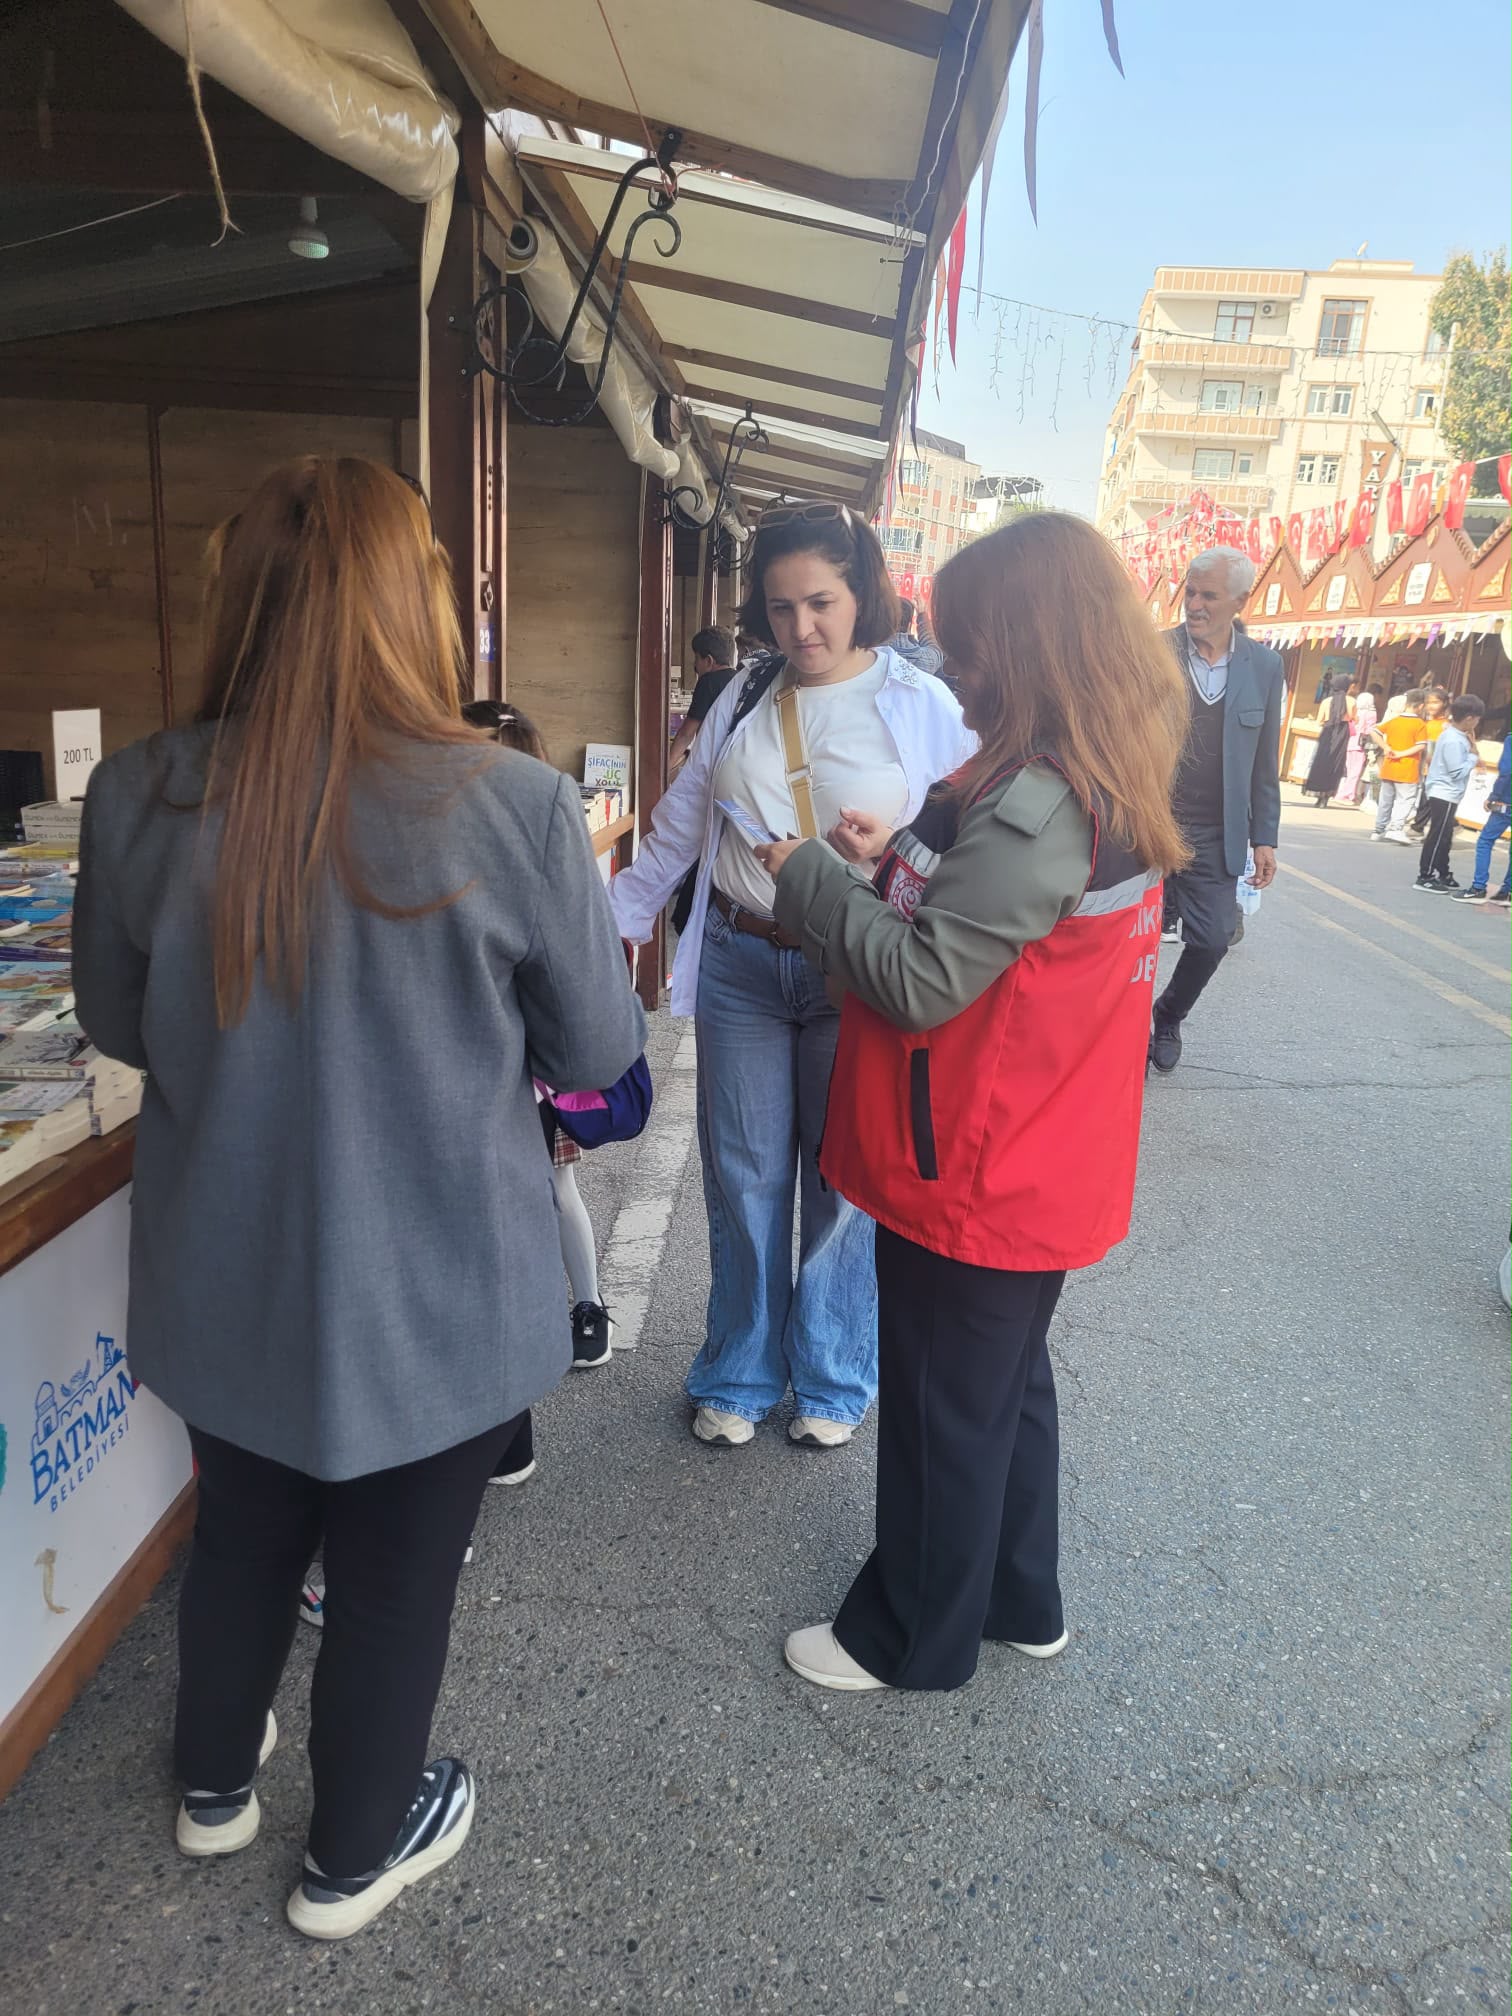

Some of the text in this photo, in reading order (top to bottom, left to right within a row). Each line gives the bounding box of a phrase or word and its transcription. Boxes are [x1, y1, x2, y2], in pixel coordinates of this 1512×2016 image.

[63, 747, 94, 764] 200 TL
[30, 1370, 136, 1505] BATMAN
[51, 1412, 129, 1513] BELEDİYESİ
